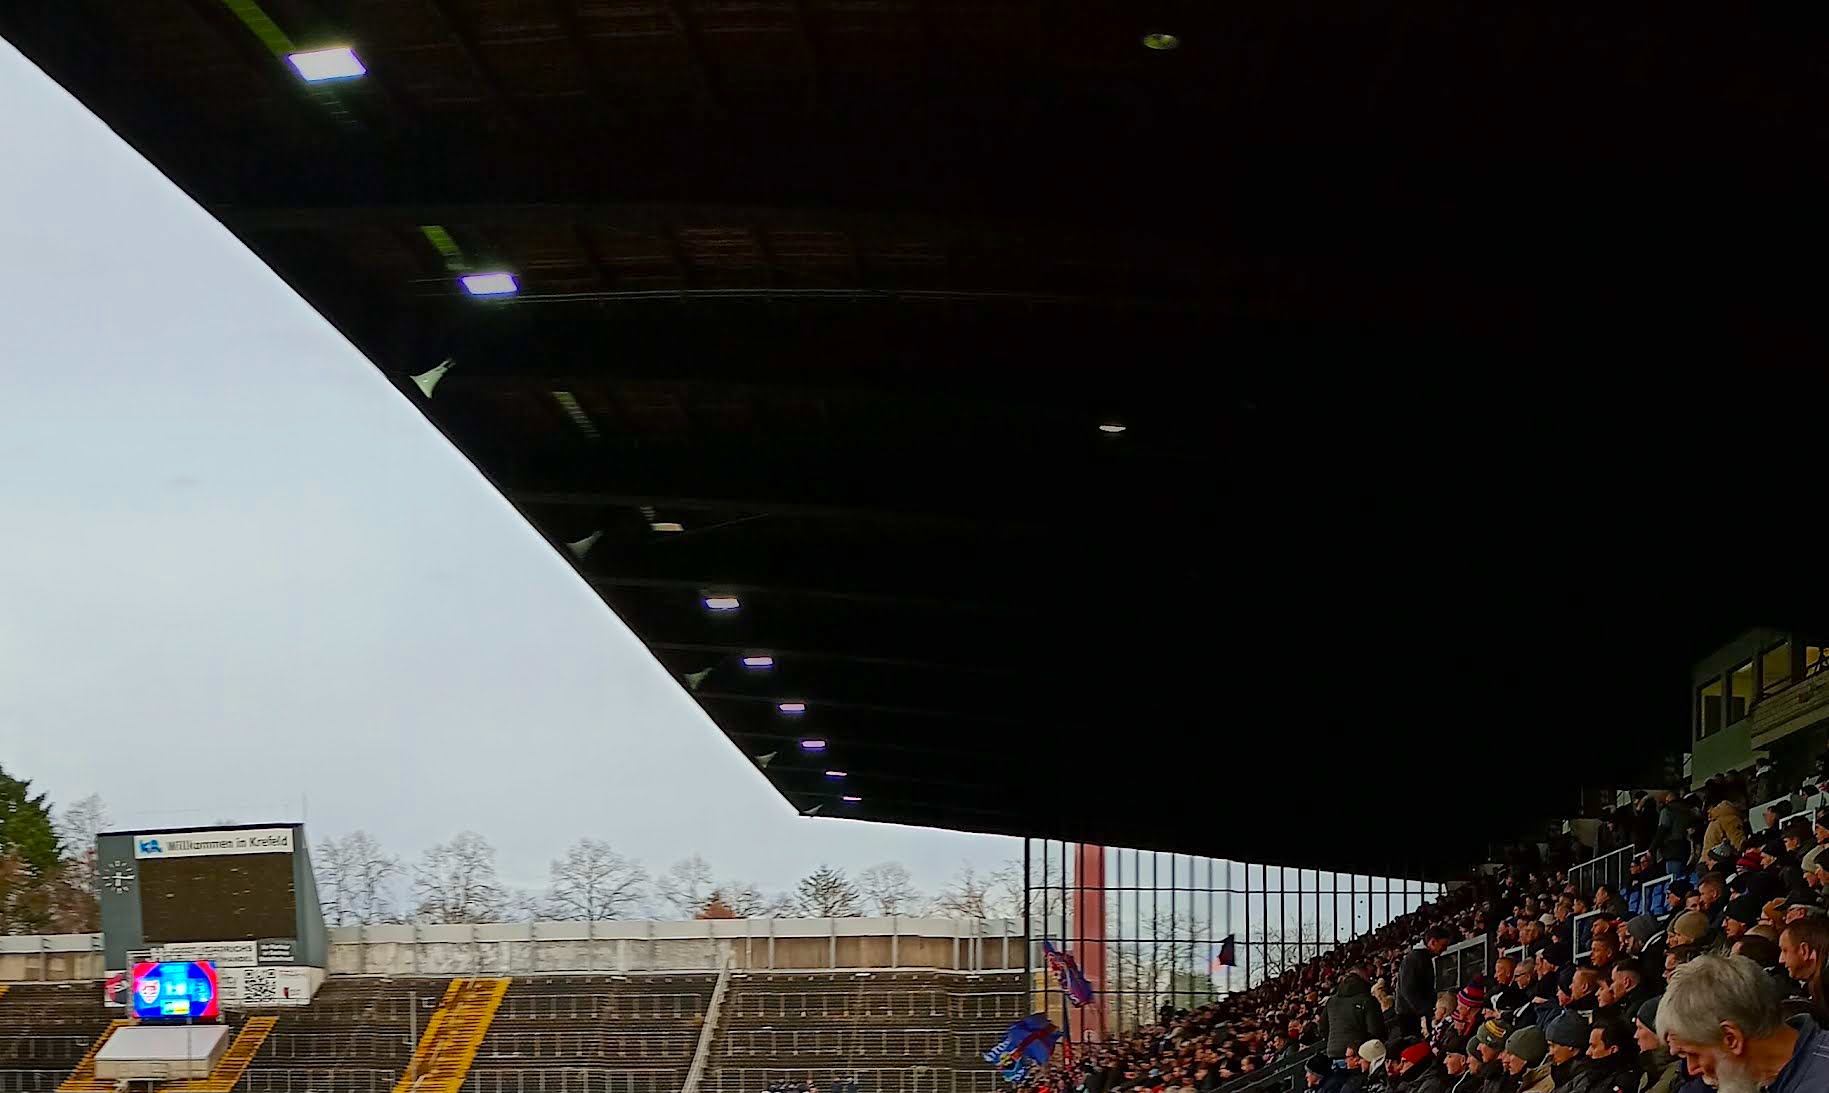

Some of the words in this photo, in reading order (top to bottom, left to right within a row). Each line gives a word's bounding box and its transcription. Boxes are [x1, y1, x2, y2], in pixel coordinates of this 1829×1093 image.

[165, 838, 234, 851] Willkommen
[235, 837, 247, 848] in
[249, 835, 288, 848] Krefeld
